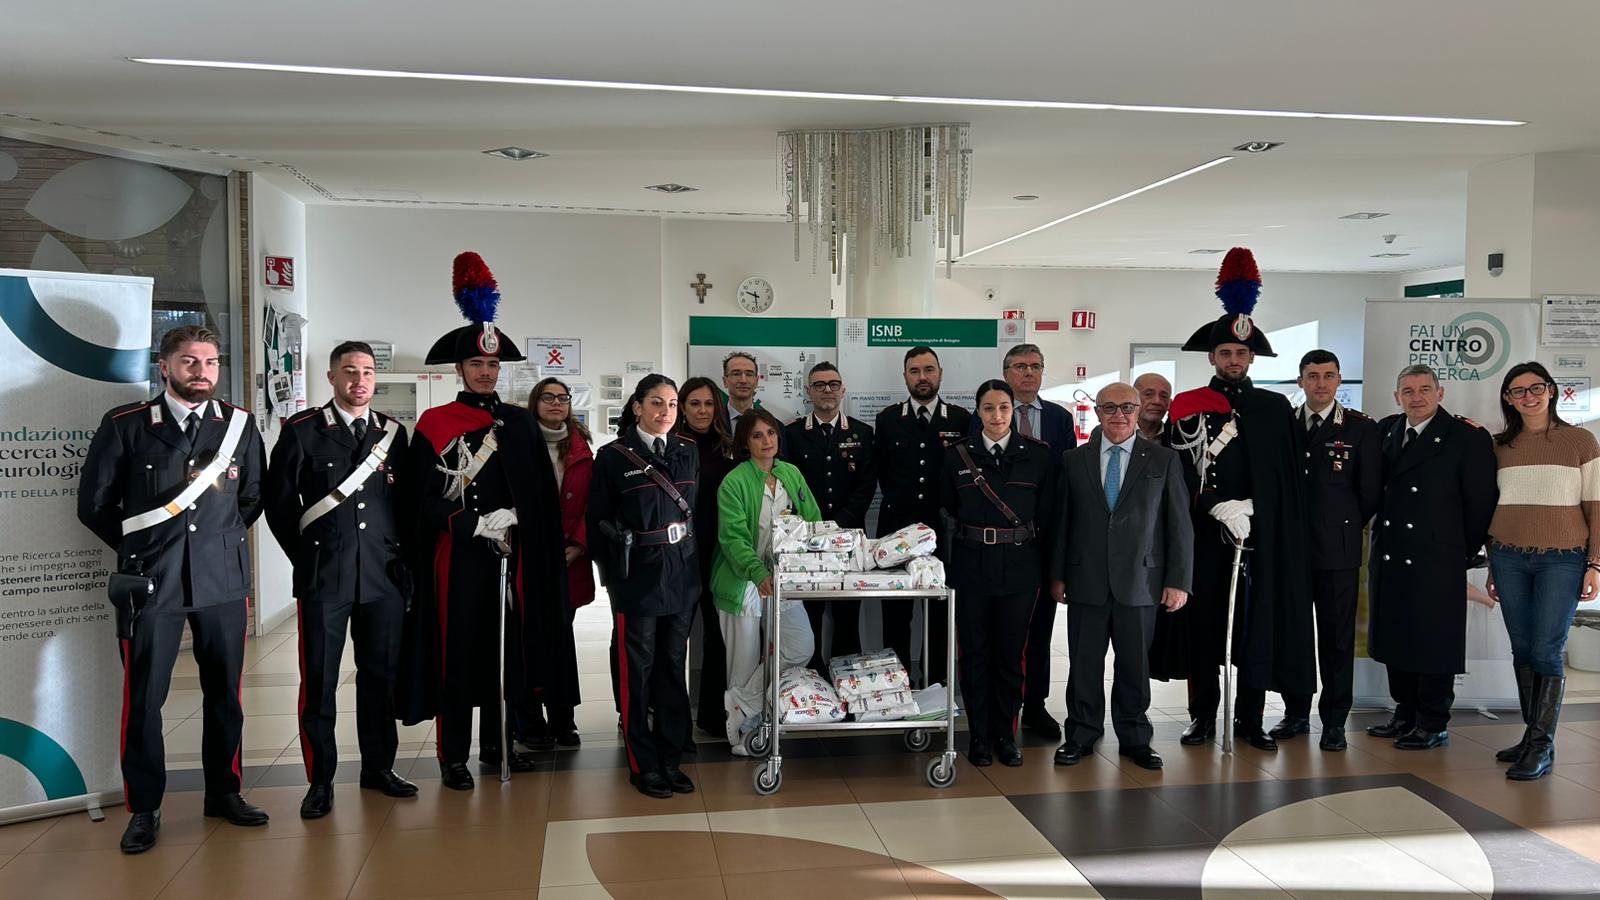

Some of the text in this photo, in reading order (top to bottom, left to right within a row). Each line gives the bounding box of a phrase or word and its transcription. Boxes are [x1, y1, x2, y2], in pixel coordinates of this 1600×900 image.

[871, 324, 903, 337] ISNB
[1410, 324, 1465, 338] FAI UN
[1409, 339, 1482, 352] CENTRO
[1409, 353, 1465, 367] PER LA
[1433, 368, 1480, 381] ERCA
[0, 448, 57, 460] cerca
[21, 488, 59, 498] DELLA
[22, 551, 61, 561] Ricerca
[64, 548, 103, 558] Scienze
[18, 564, 27, 572] si
[30, 561, 76, 572] impegna
[79, 558, 101, 569] ogni
[43, 573, 53, 582] la
[55, 571, 90, 581] ricerca
[92, 569, 109, 579] più
[2, 581, 106, 596] campo neurologico
[1, 602, 105, 619] centro la salute della
[54, 617, 63, 626] di
[66, 615, 81, 625] chi
[97, 613, 109, 621] ne
[31, 630, 57, 640] cura.
